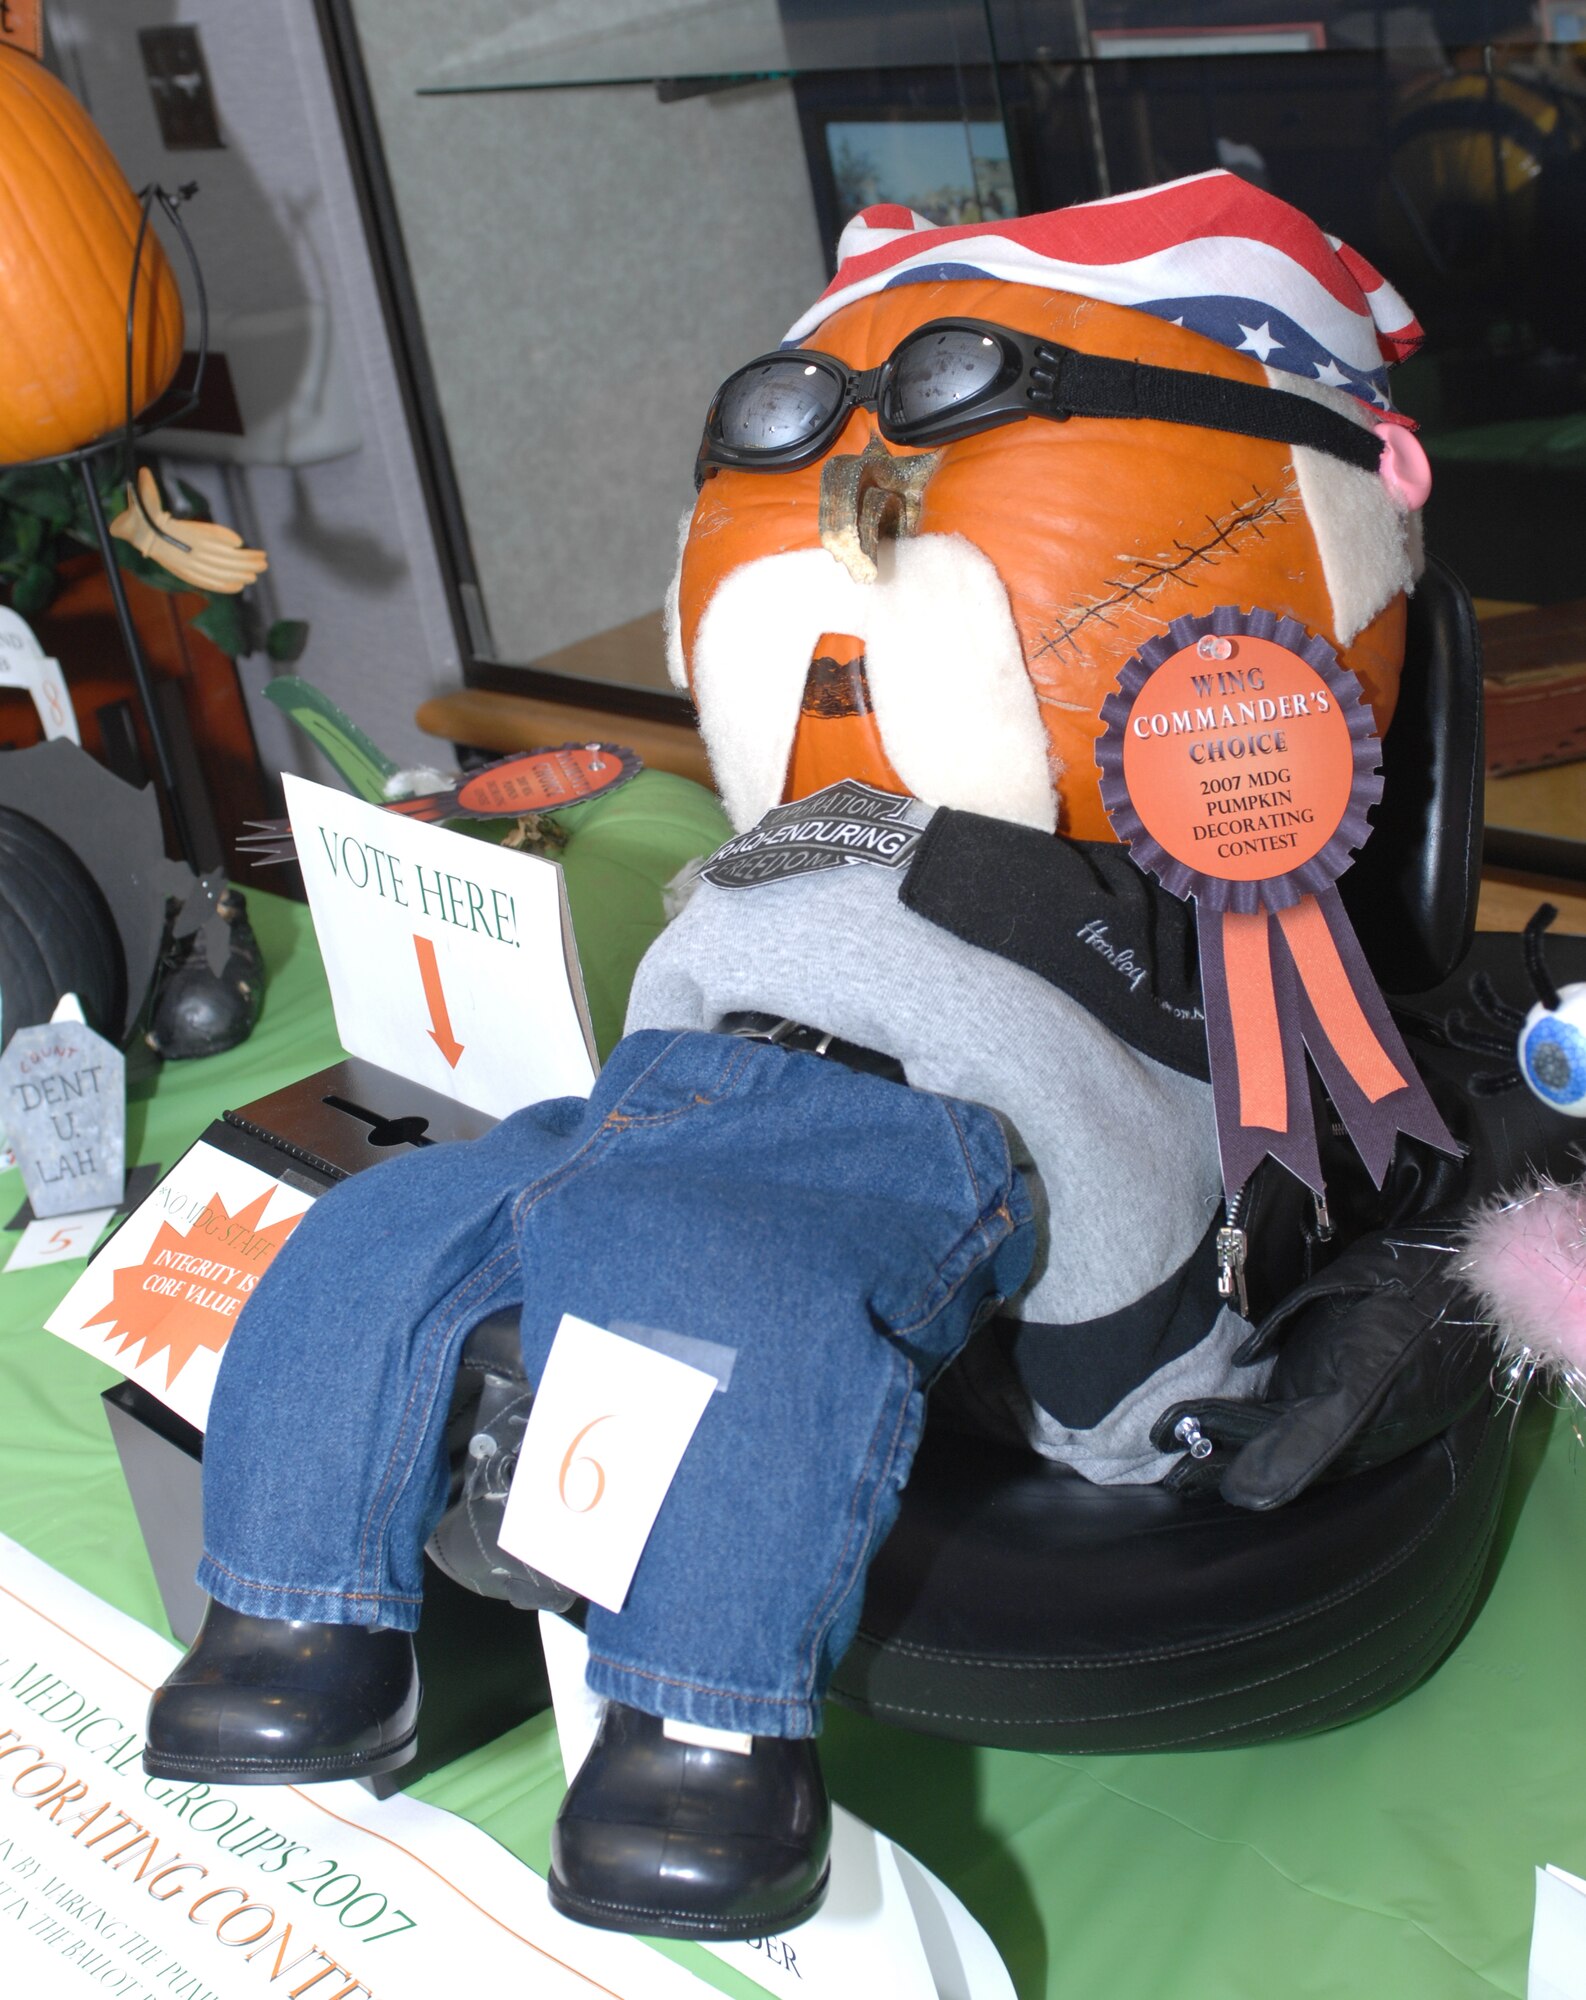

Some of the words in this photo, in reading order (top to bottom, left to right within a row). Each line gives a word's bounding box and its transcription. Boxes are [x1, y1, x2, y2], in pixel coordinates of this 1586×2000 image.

[1190, 667, 1265, 698] WING
[42, 679, 64, 727] 8
[1133, 690, 1331, 740] COMMANDER'S
[1188, 729, 1289, 765] CHOICE
[1200, 776, 1242, 796] 2007
[1248, 768, 1292, 789] MDG
[771, 792, 881, 825] OPERATION
[1206, 790, 1293, 818] PUMPKIN
[1192, 808, 1315, 841] DECORATING
[1217, 832, 1299, 859] CONTEST
[716, 851, 833, 881] FREEDOM
[318, 825, 409, 908] VOTE
[414, 864, 521, 949] HERE!
[1076, 919, 1148, 993] Harley
[20, 1046, 78, 1074] COUNT
[12, 1065, 102, 1112] DENT
[50, 1112, 81, 1141] U.
[35, 1148, 97, 1184] LAH
[38, 1225, 84, 1255] 5
[217, 1222, 276, 1262] STAFF
[152, 1248, 242, 1286] INTEGRITY
[235, 1273, 261, 1293] IS
[142, 1273, 187, 1298] CORE
[184, 1283, 242, 1317] VALUE
[558, 1414, 620, 1514] 6
[9, 1661, 146, 1777] MEDICAL
[144, 1776, 311, 1874] GROUP'S
[287, 1859, 418, 1943] 2007
[36, 1876, 128, 1940] MARKING
[119, 1930, 167, 1966] THE
[28, 1912, 75, 1948] THE
[61, 1938, 143, 1997] BALLOT
